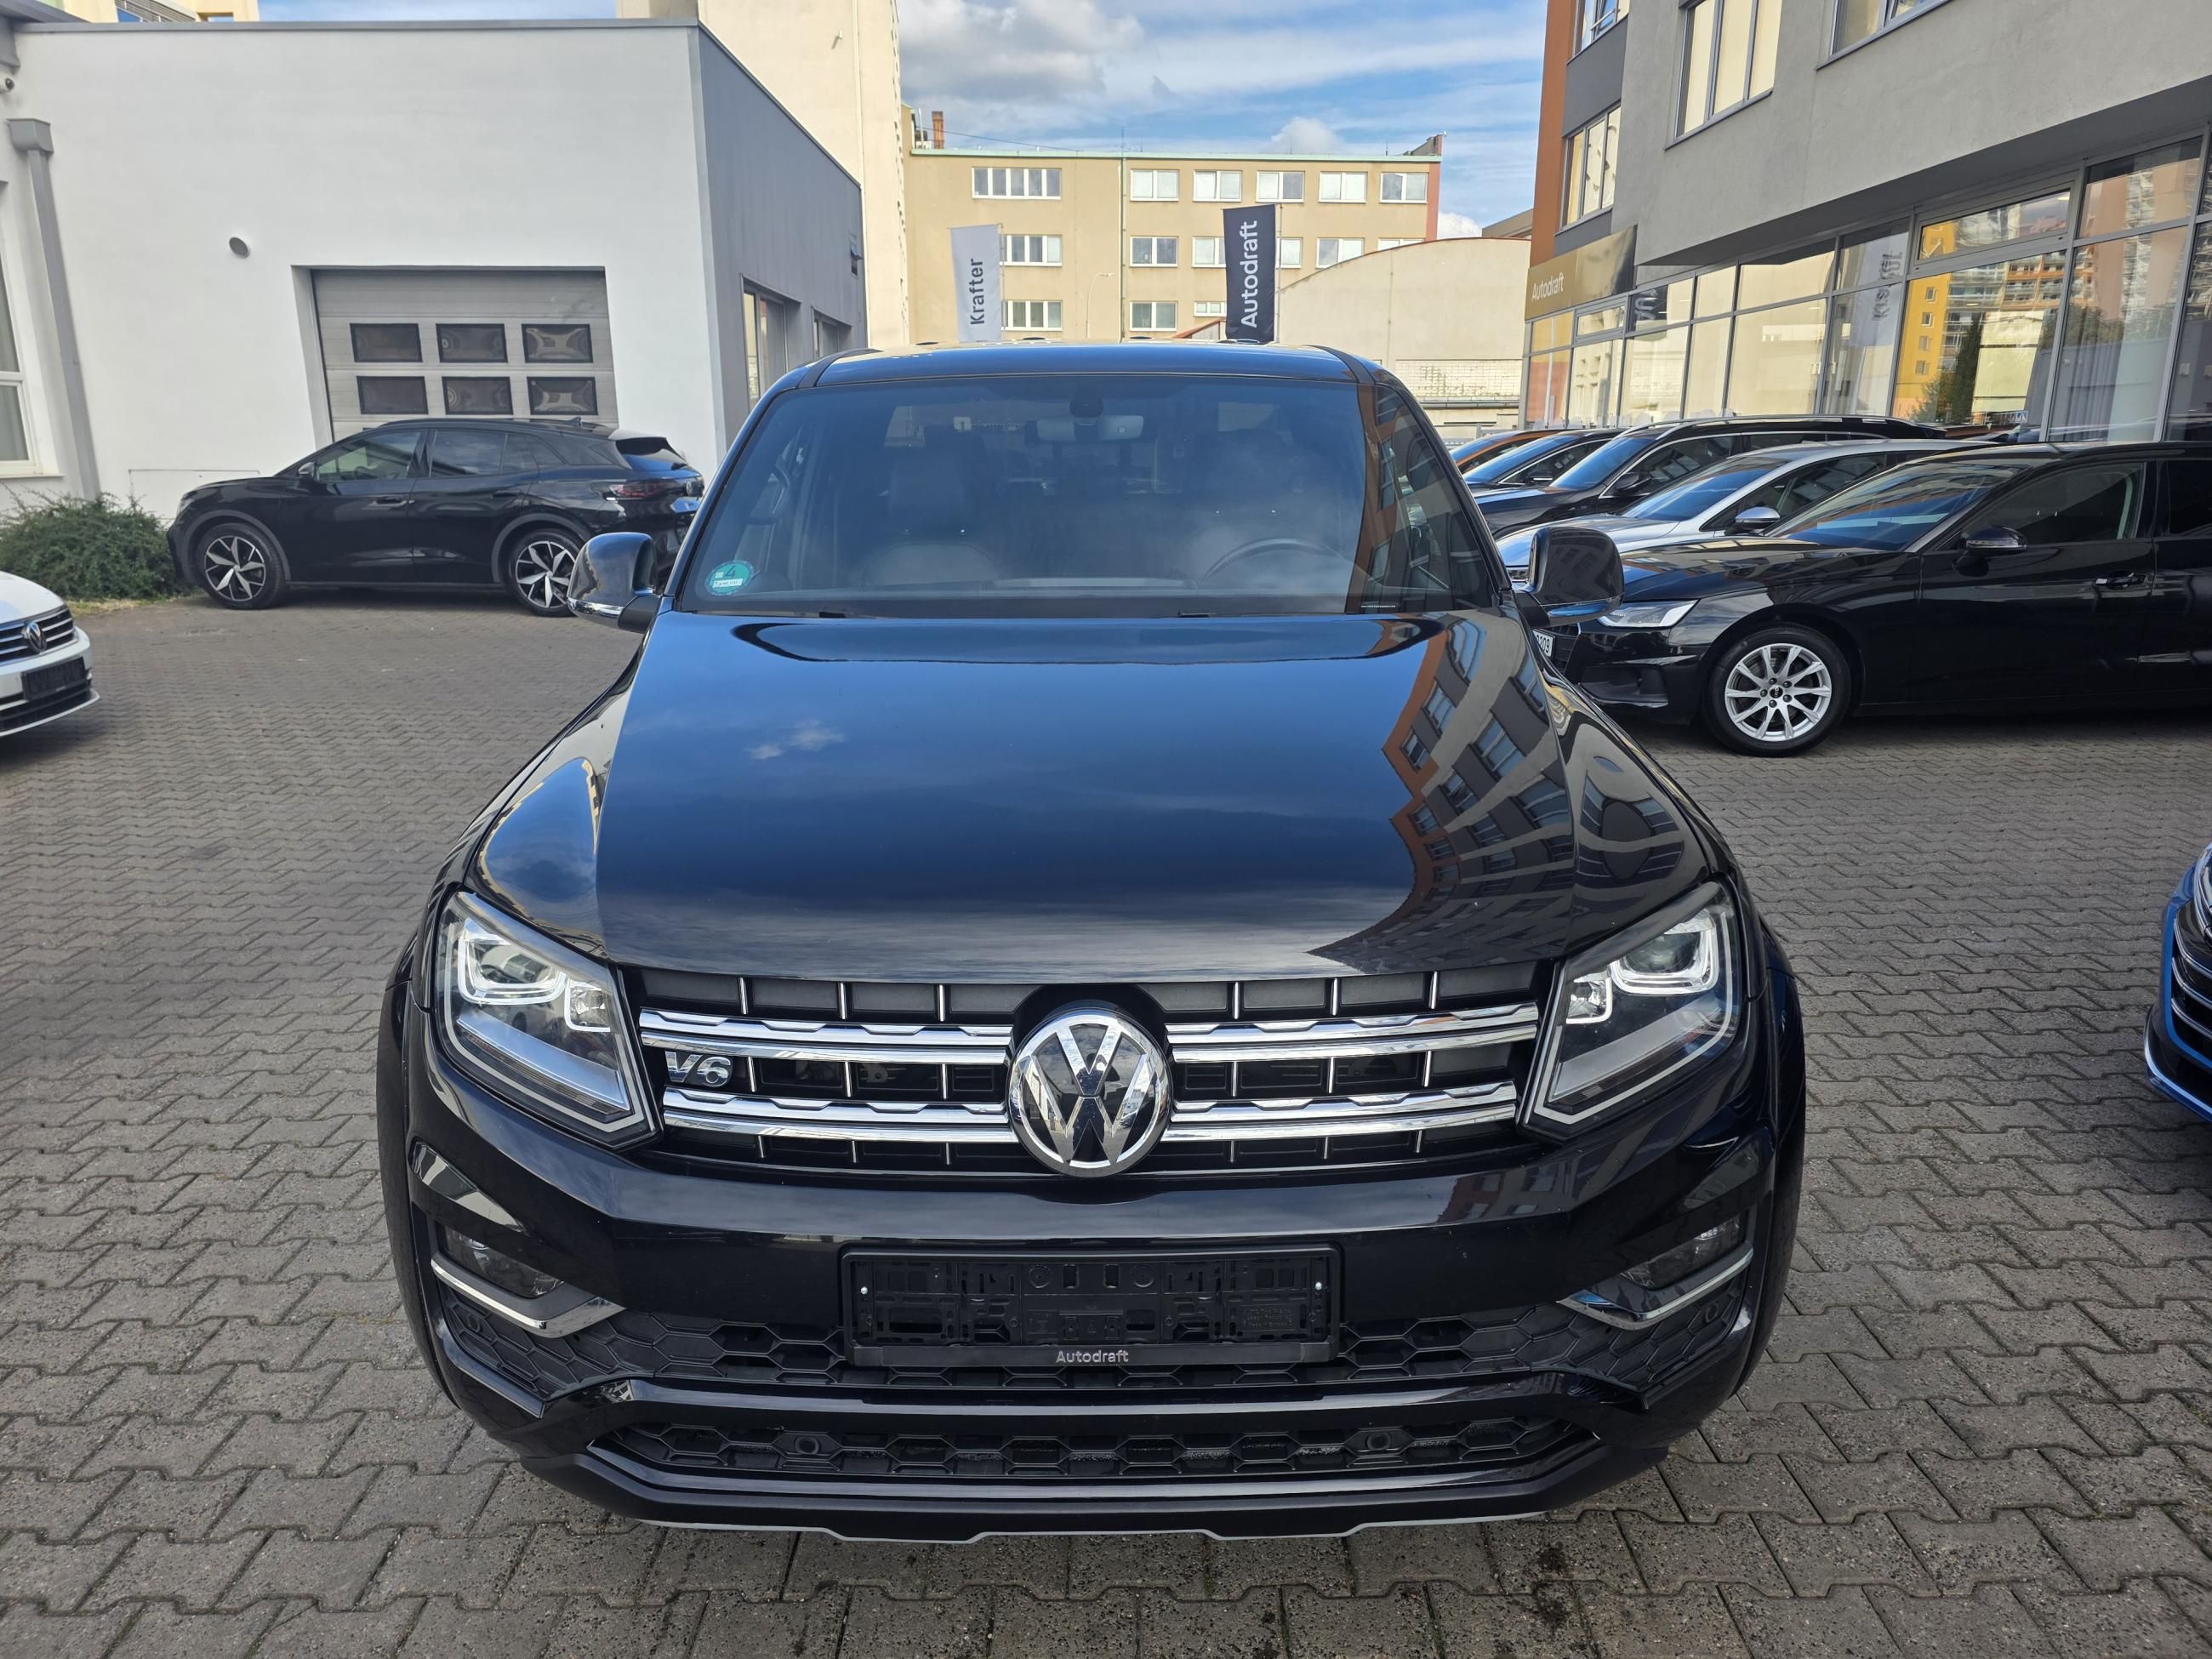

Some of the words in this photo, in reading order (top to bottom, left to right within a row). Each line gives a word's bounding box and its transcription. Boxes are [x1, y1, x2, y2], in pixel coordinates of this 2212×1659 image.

[969, 258, 984, 325] Krafter
[1239, 220, 1258, 328] Autodraft
[1531, 271, 1565, 300] Autodraft
[664, 1051, 732, 1087] V6
[1011, 1011, 1169, 1173] VW
[1056, 1349, 1129, 1363] Autodraft
